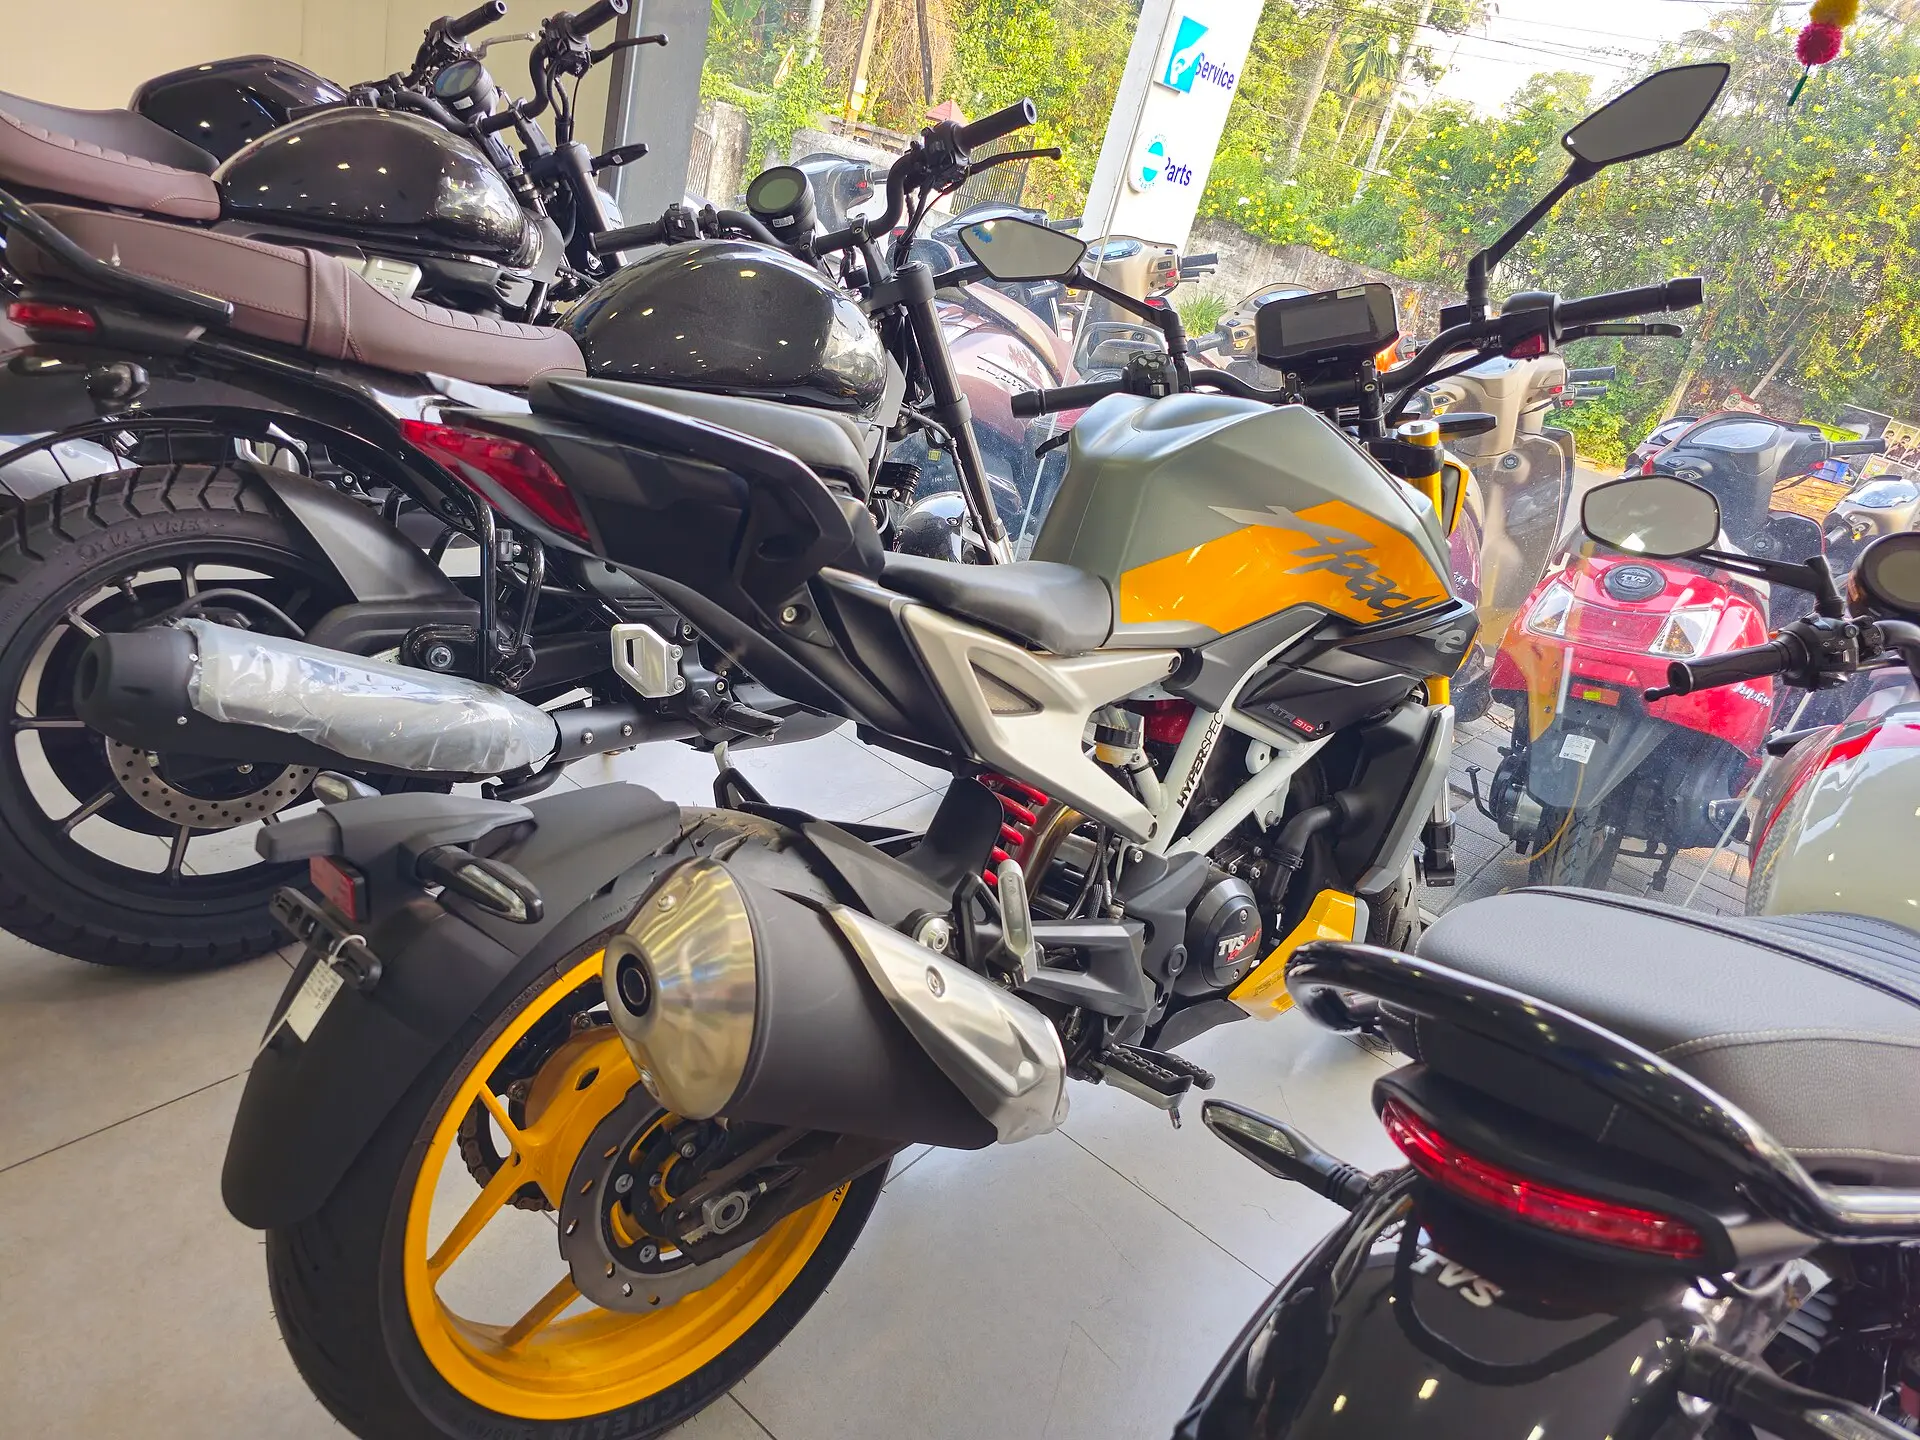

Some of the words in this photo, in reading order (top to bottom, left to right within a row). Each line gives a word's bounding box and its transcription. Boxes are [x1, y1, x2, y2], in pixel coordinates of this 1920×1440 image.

[1195, 52, 1235, 90] Service
[1620, 573, 1648, 583] TVS
[1266, 703, 1295, 723] RTR
[1293, 718, 1315, 733] 310
[1176, 711, 1223, 809] HYPERSPEC
[1218, 934, 1246, 956] TVS
[1408, 1247, 1504, 1307] TVS
